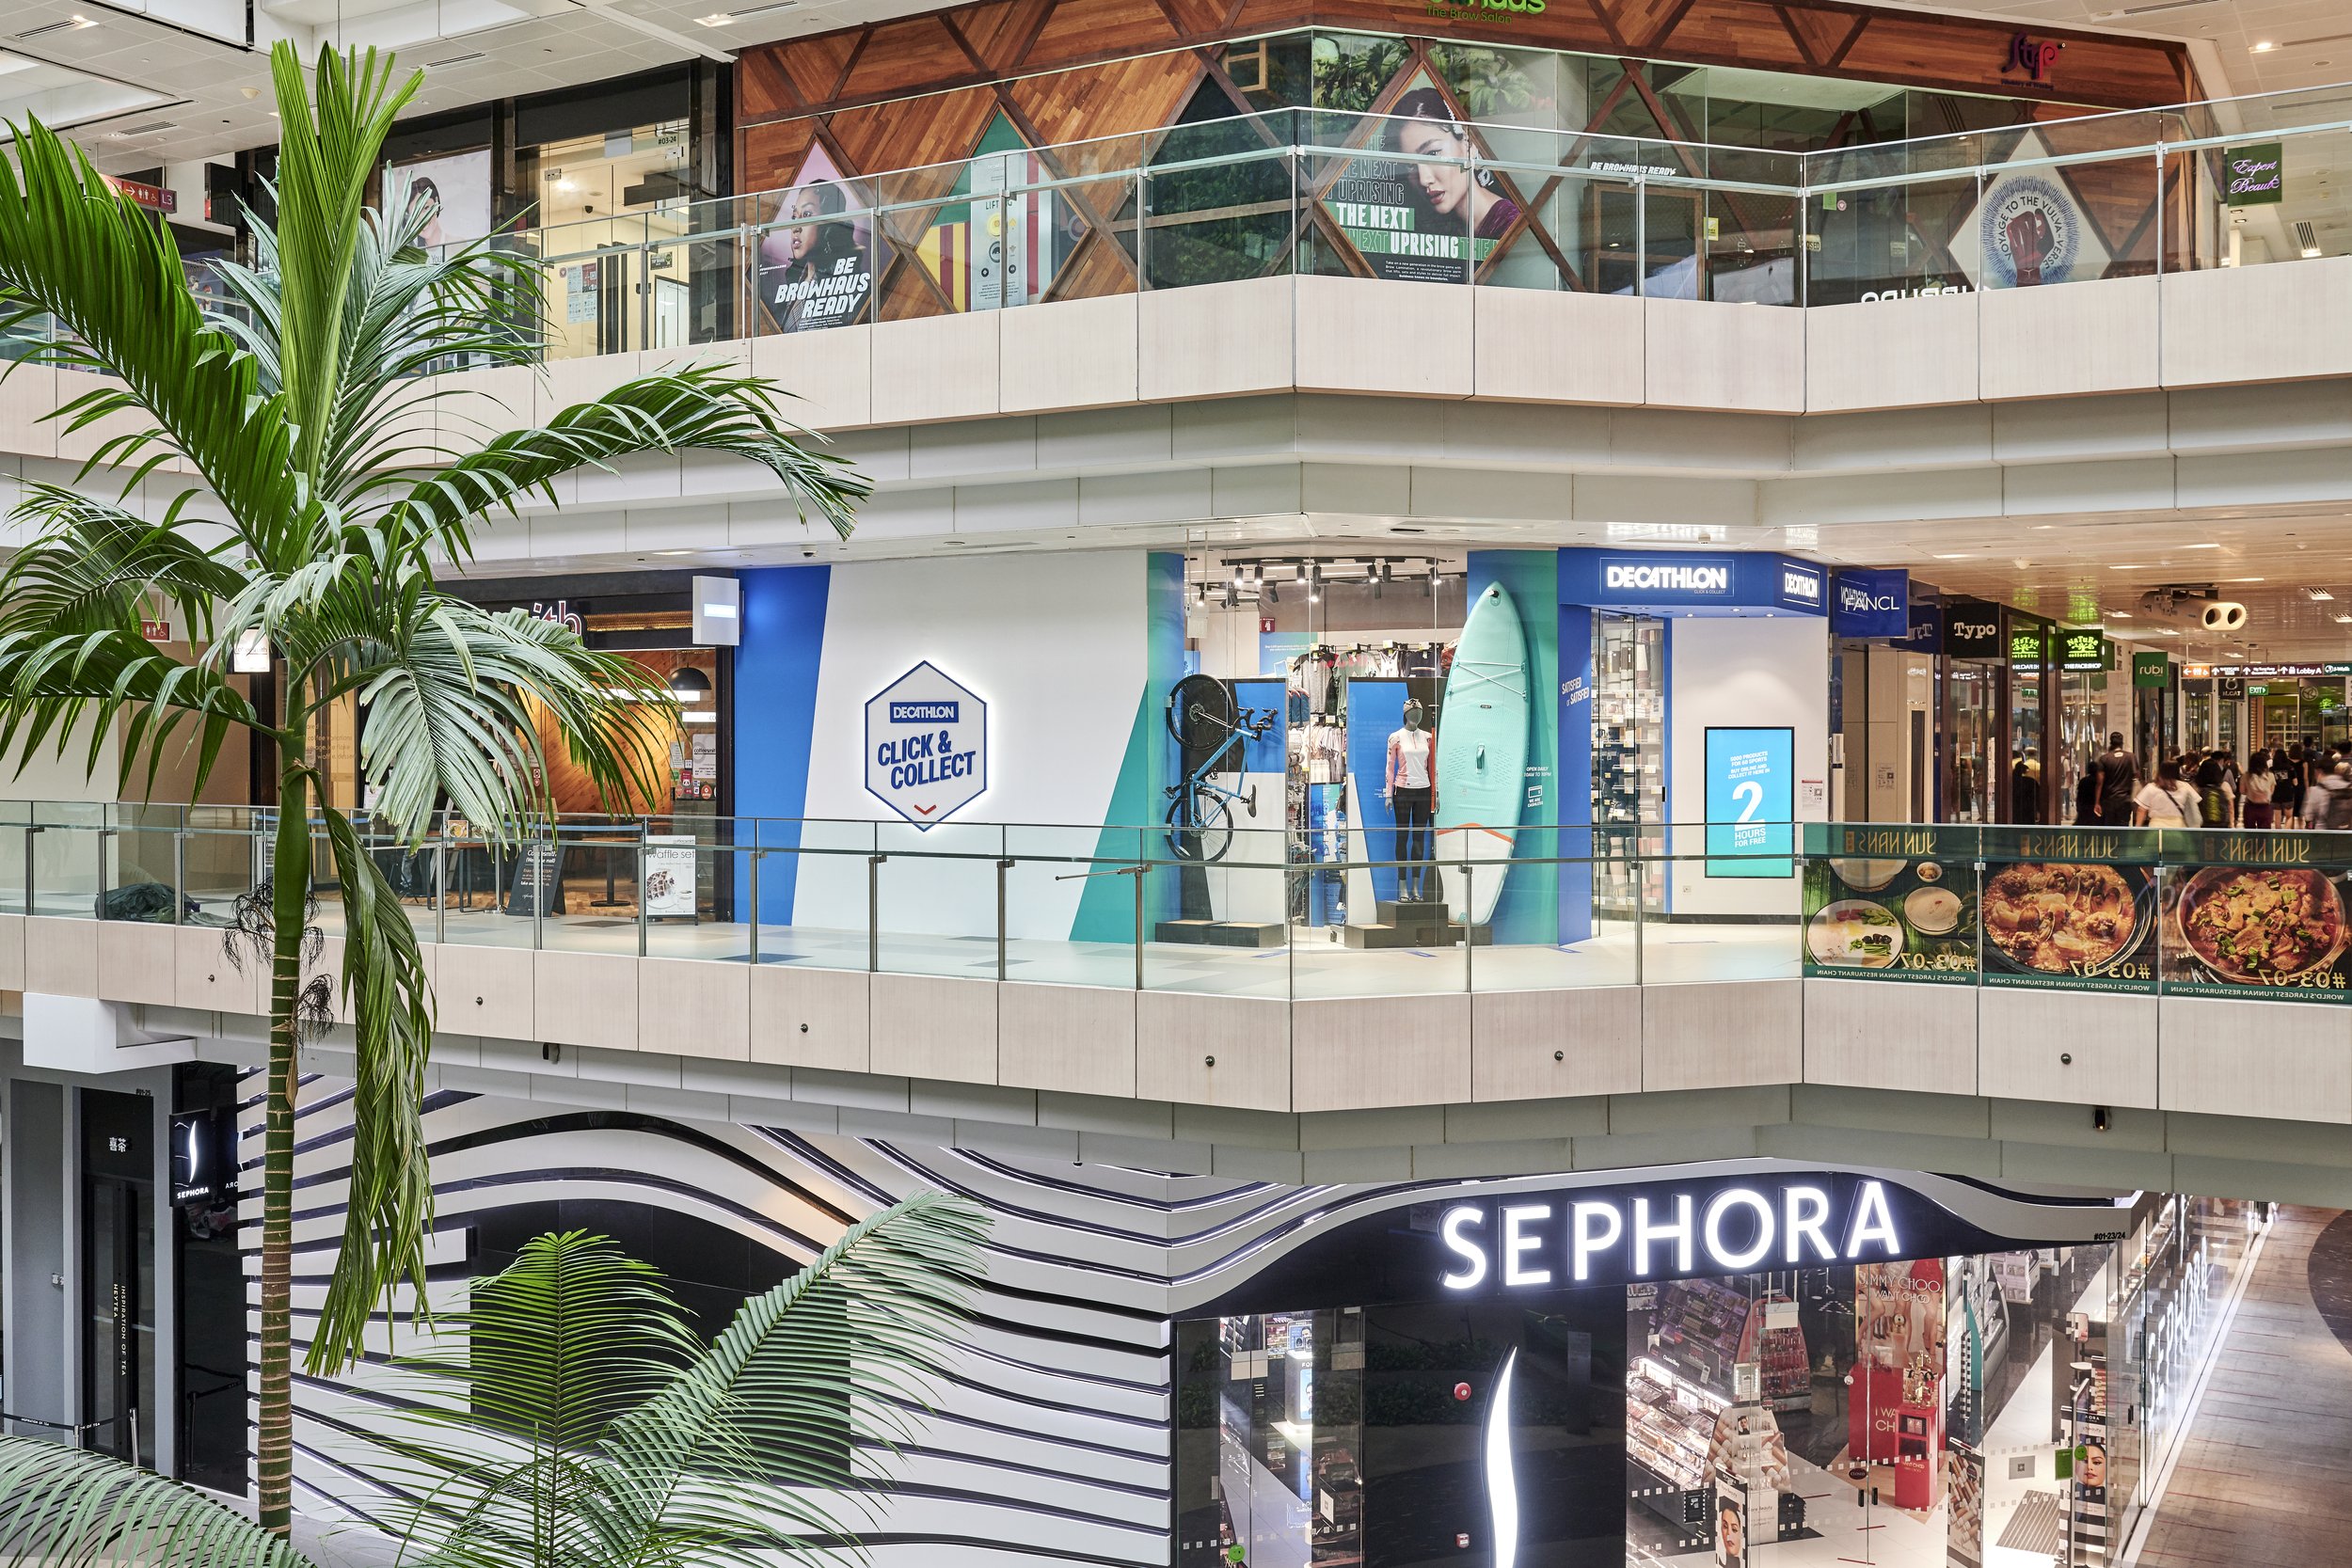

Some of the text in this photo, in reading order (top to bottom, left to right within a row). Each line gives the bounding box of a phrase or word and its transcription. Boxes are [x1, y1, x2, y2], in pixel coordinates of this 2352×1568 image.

[1426, 6, 1446, 17] The
[1450, 8, 1478, 21] Brow
[1481, 11, 1512, 24] Salon
[1590, 162, 1603, 170] BE
[1647, 166, 1677, 176] READY
[2232, 159, 2278, 176] Expert
[161, 195, 174, 206] L3
[1339, 180, 1405, 205] UPRISING
[1336, 202, 1410, 230] THE NEXT
[1998, 213, 2013, 261] VOYAGE
[2006, 200, 2019, 214] TO
[2020, 196, 2040, 207] THE
[1390, 231, 1459, 258] UPRISING
[834, 257, 858, 276] BE
[774, 273, 870, 304] BROWHAUS
[802, 293, 864, 319] READY
[1606, 566, 1727, 589] DECATHLON
[1784, 572, 1819, 599] DECATHLON
[1845, 596, 1900, 611] FANCL
[1953, 622, 1996, 640] Typo
[893, 706, 955, 719] DECATHLON
[878, 730, 952, 767] CLICK &
[1742, 751, 1769, 759] PRODUCTS
[890, 751, 977, 790] COLLECT
[1732, 781, 1766, 832] 2
[1734, 828, 1767, 840] HOURS
[1735, 836, 1767, 847] FOR FREE
[680, 849, 695, 859] set
[176, 1187, 209, 1199] SEPHORA
[1441, 1181, 1900, 1290] SEPHORA
[2093, 1231, 2126, 1240] #01-23/24
[121, 1343, 126, 1356] OF
